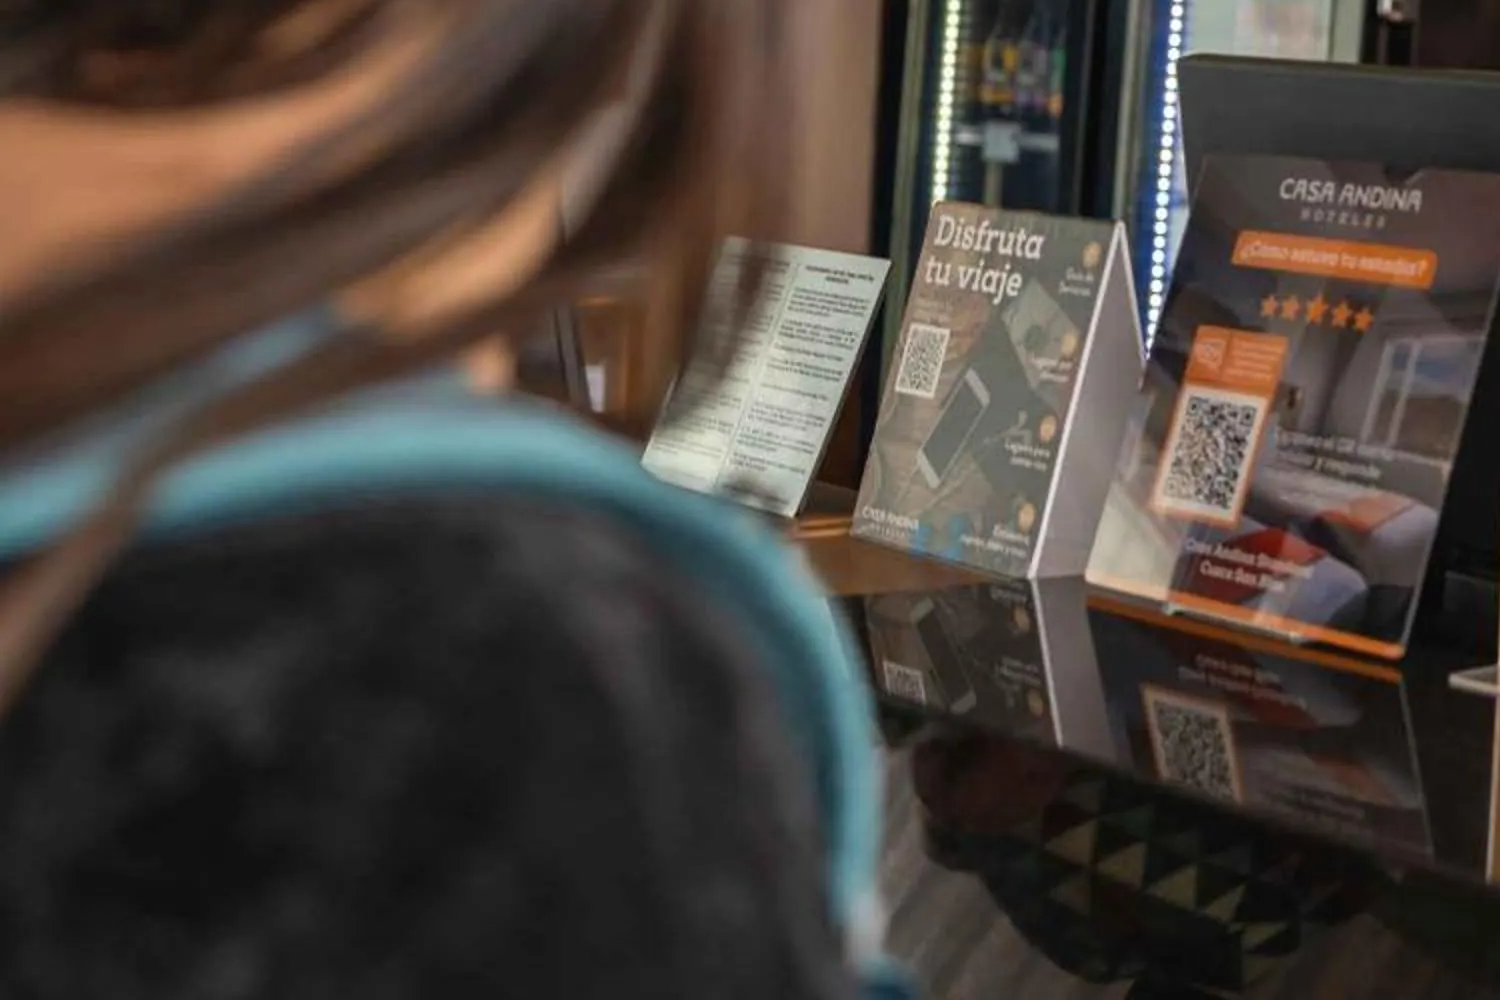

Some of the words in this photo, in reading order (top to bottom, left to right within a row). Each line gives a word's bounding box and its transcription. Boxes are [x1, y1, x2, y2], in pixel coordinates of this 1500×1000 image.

[1279, 177, 1335, 204] CASA
[1338, 183, 1423, 214] ANDINA
[933, 214, 1046, 260] Disfruta
[925, 255, 951, 287] tu
[957, 259, 1023, 305] viaje
